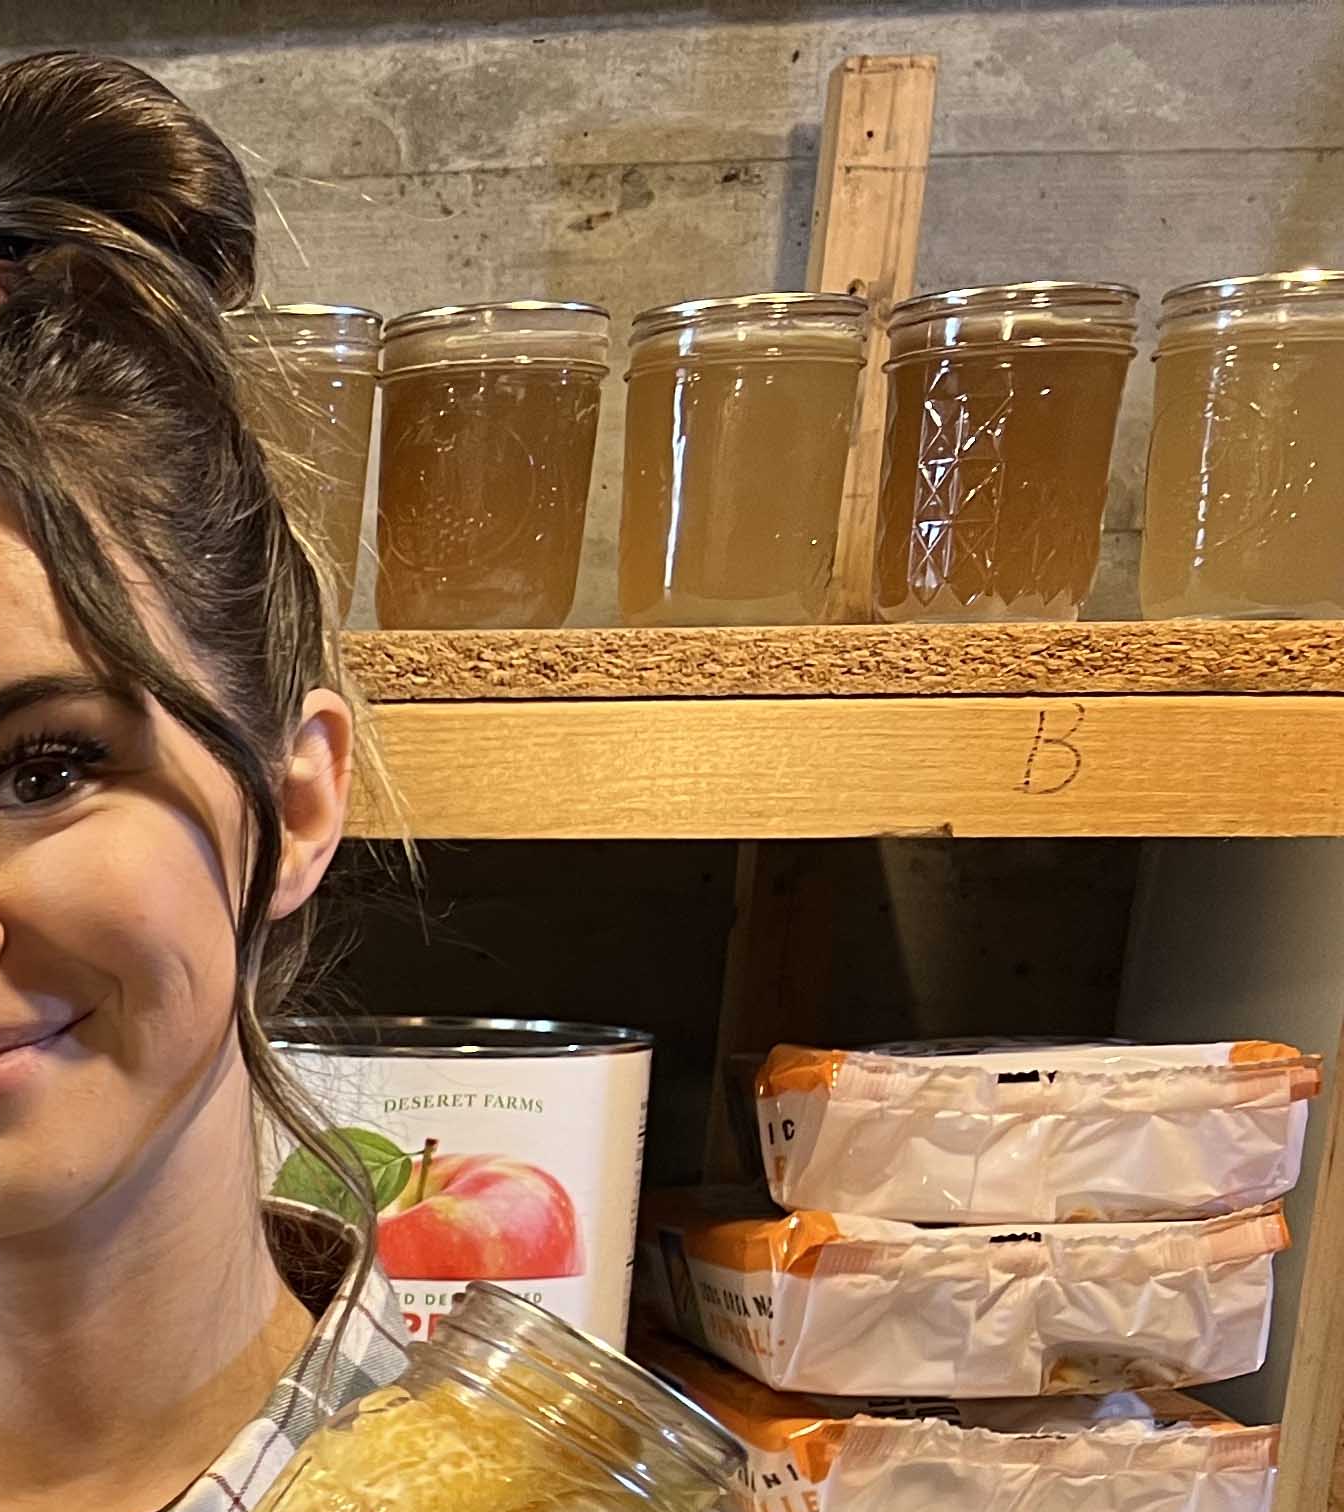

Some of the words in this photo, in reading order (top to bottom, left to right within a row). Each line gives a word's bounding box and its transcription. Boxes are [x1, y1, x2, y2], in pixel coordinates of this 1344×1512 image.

[1013, 702, 1086, 795] B
[383, 1093, 477, 1114] DESERET
[483, 1093, 545, 1114] FARMS
